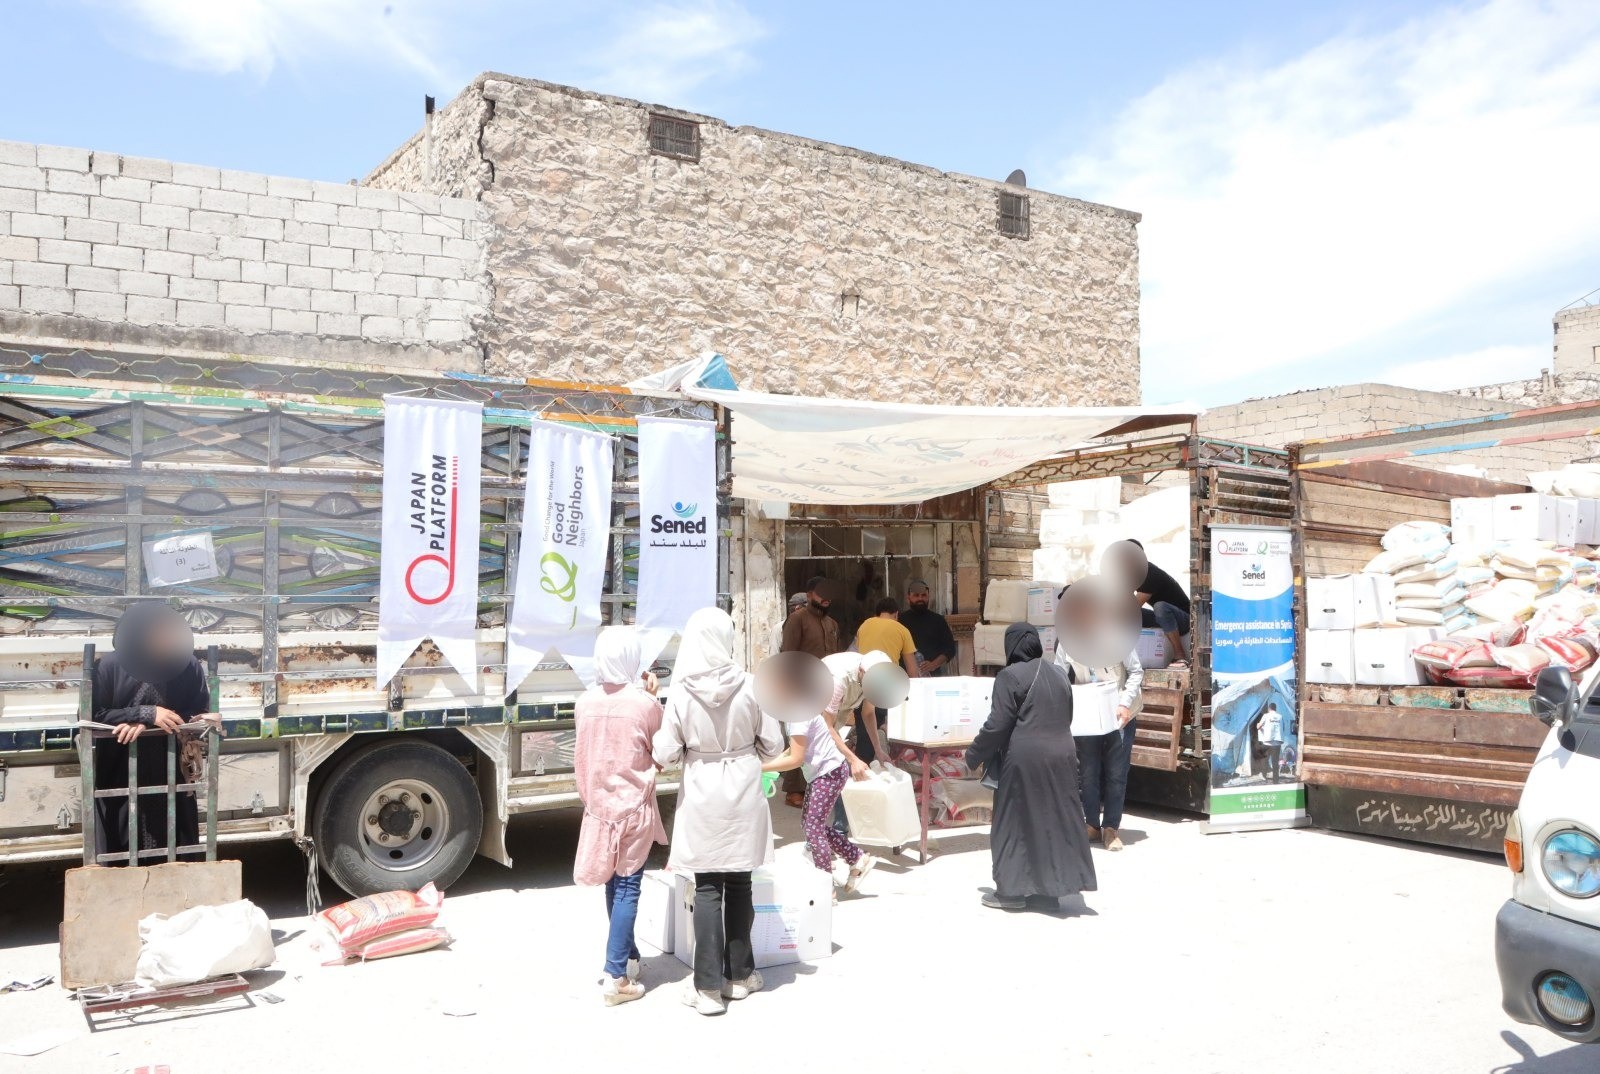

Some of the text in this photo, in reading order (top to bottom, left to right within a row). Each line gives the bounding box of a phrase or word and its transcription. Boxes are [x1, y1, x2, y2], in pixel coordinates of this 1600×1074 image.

[410, 472, 427, 534] JAPAN
[430, 454, 447, 551] PLATFORM
[546, 491, 554, 501] for
[565, 465, 585, 546] Neighbors
[544, 501, 554, 525] Change
[551, 502, 566, 544] Good
[650, 514, 707, 534] Sened
[577, 528, 587, 548] Japan
[679, 539, 707, 550] للبلد
[175, 557, 186, 567] (3)
[1242, 569, 1266, 580] Sened
[1214, 619, 1293, 633] Emergency assistance in Syria
[1215, 638, 1233, 647] سوريا
[1233, 638, 1244, 649] في
[1264, 636, 1293, 644] المساعدات
